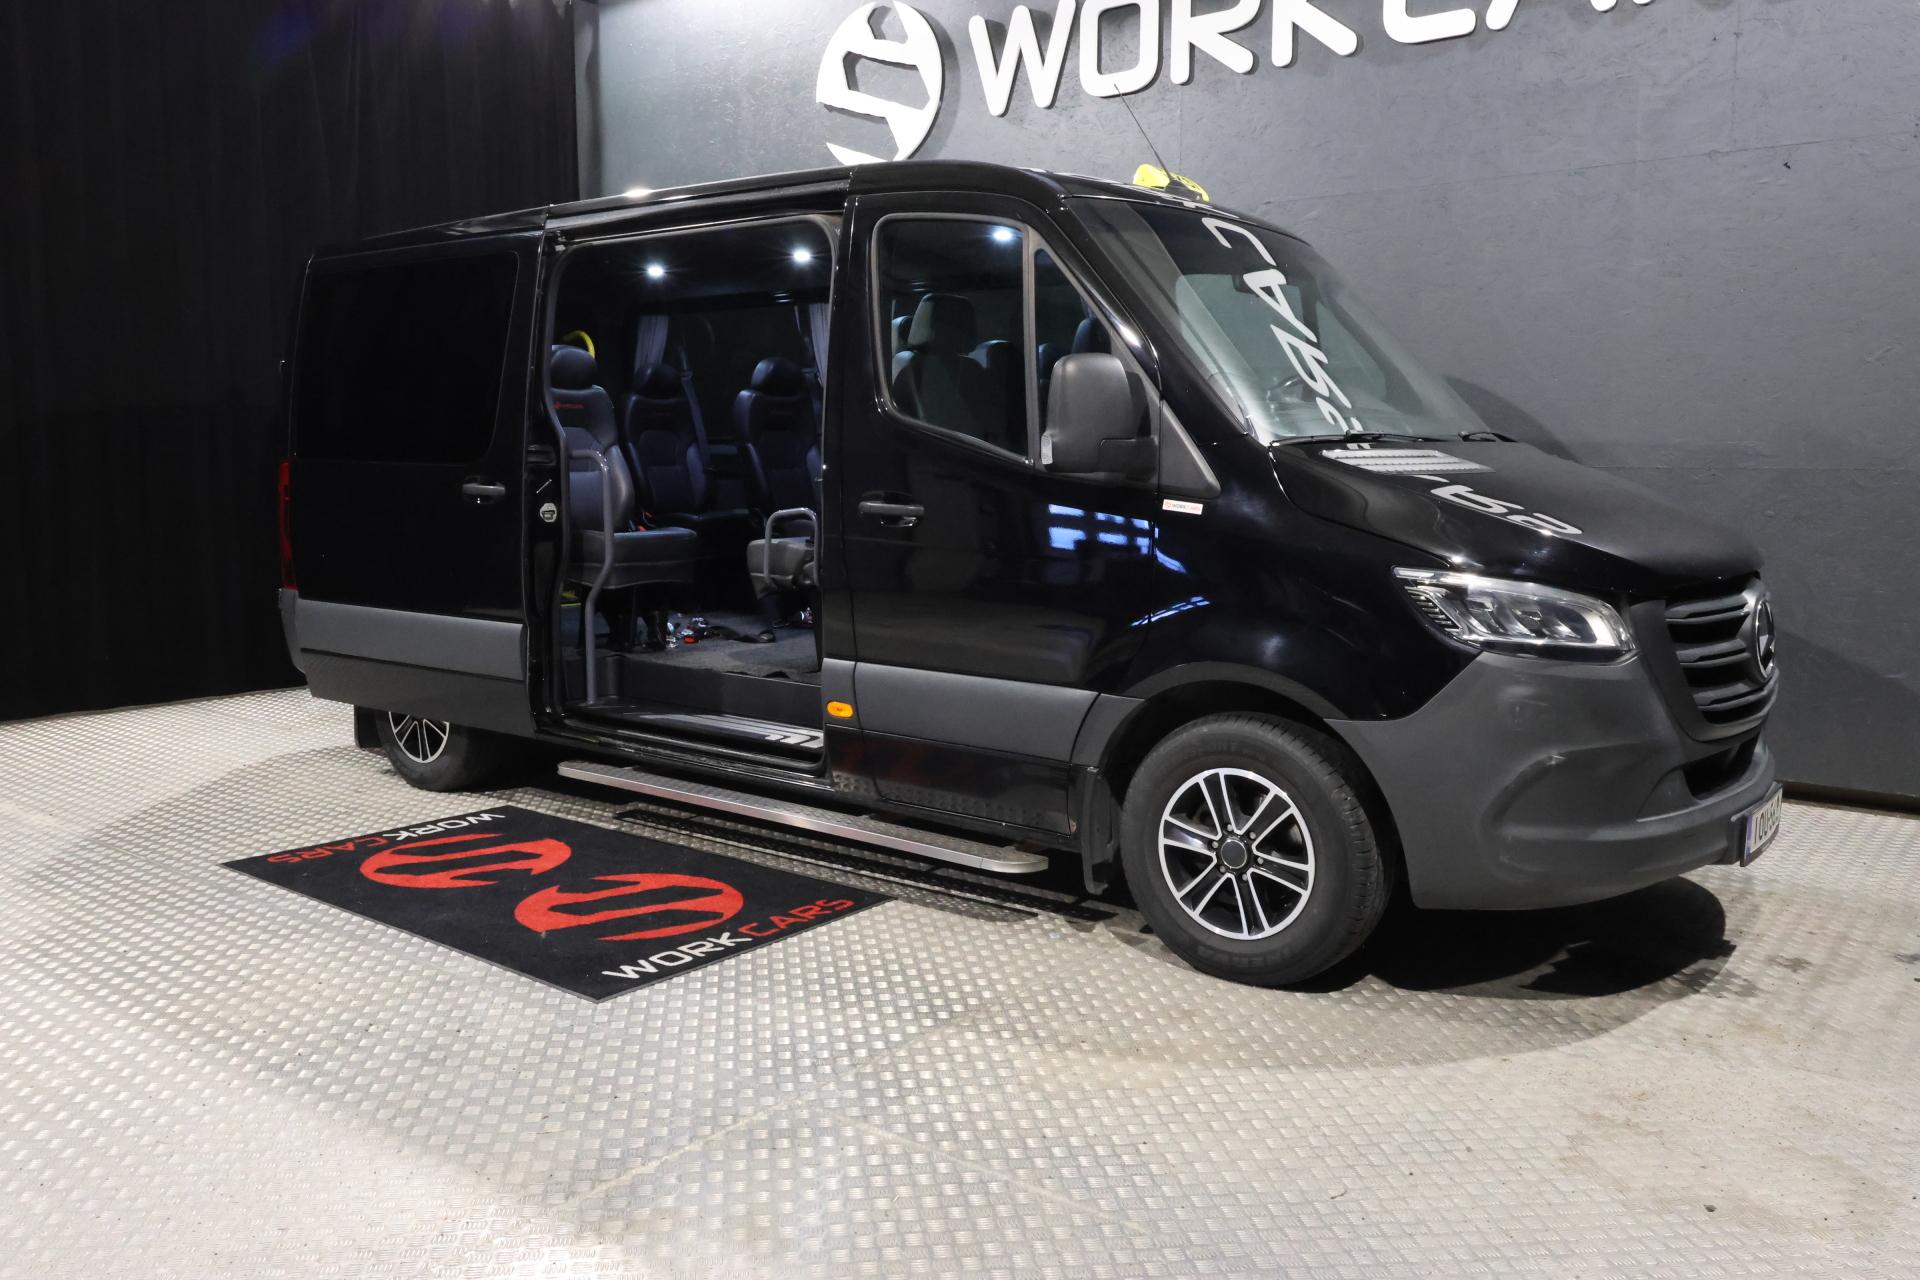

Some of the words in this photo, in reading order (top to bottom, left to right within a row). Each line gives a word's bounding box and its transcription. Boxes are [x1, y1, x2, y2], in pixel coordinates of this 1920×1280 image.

[382, 813, 506, 841] WORK
[267, 836, 389, 863] CARS
[601, 931, 752, 979] WORK
[738, 899, 855, 937] CARS
